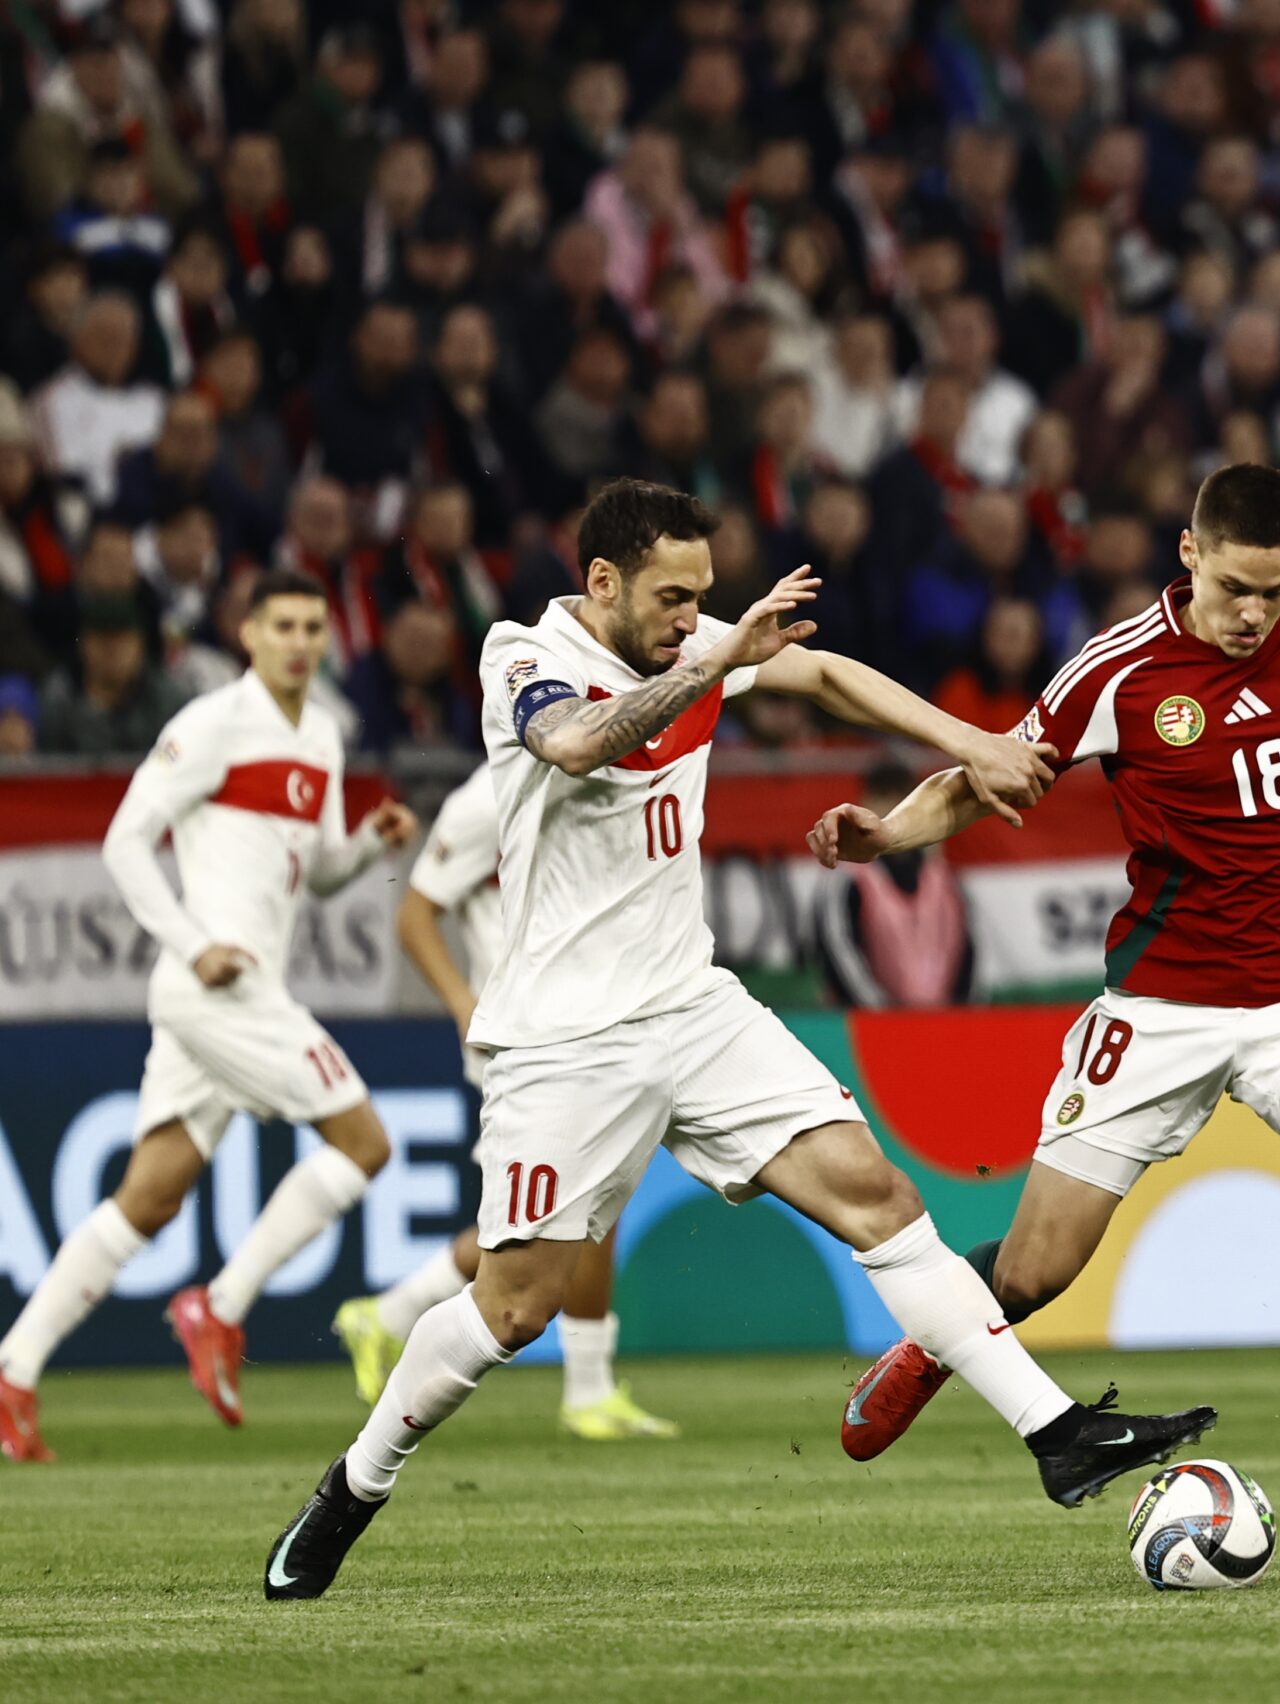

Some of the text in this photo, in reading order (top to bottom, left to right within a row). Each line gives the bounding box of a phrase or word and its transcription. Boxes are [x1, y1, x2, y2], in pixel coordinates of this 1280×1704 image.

[644, 793, 683, 861] 10
[1074, 1012, 1133, 1086] 18
[507, 1161, 559, 1227] 10
